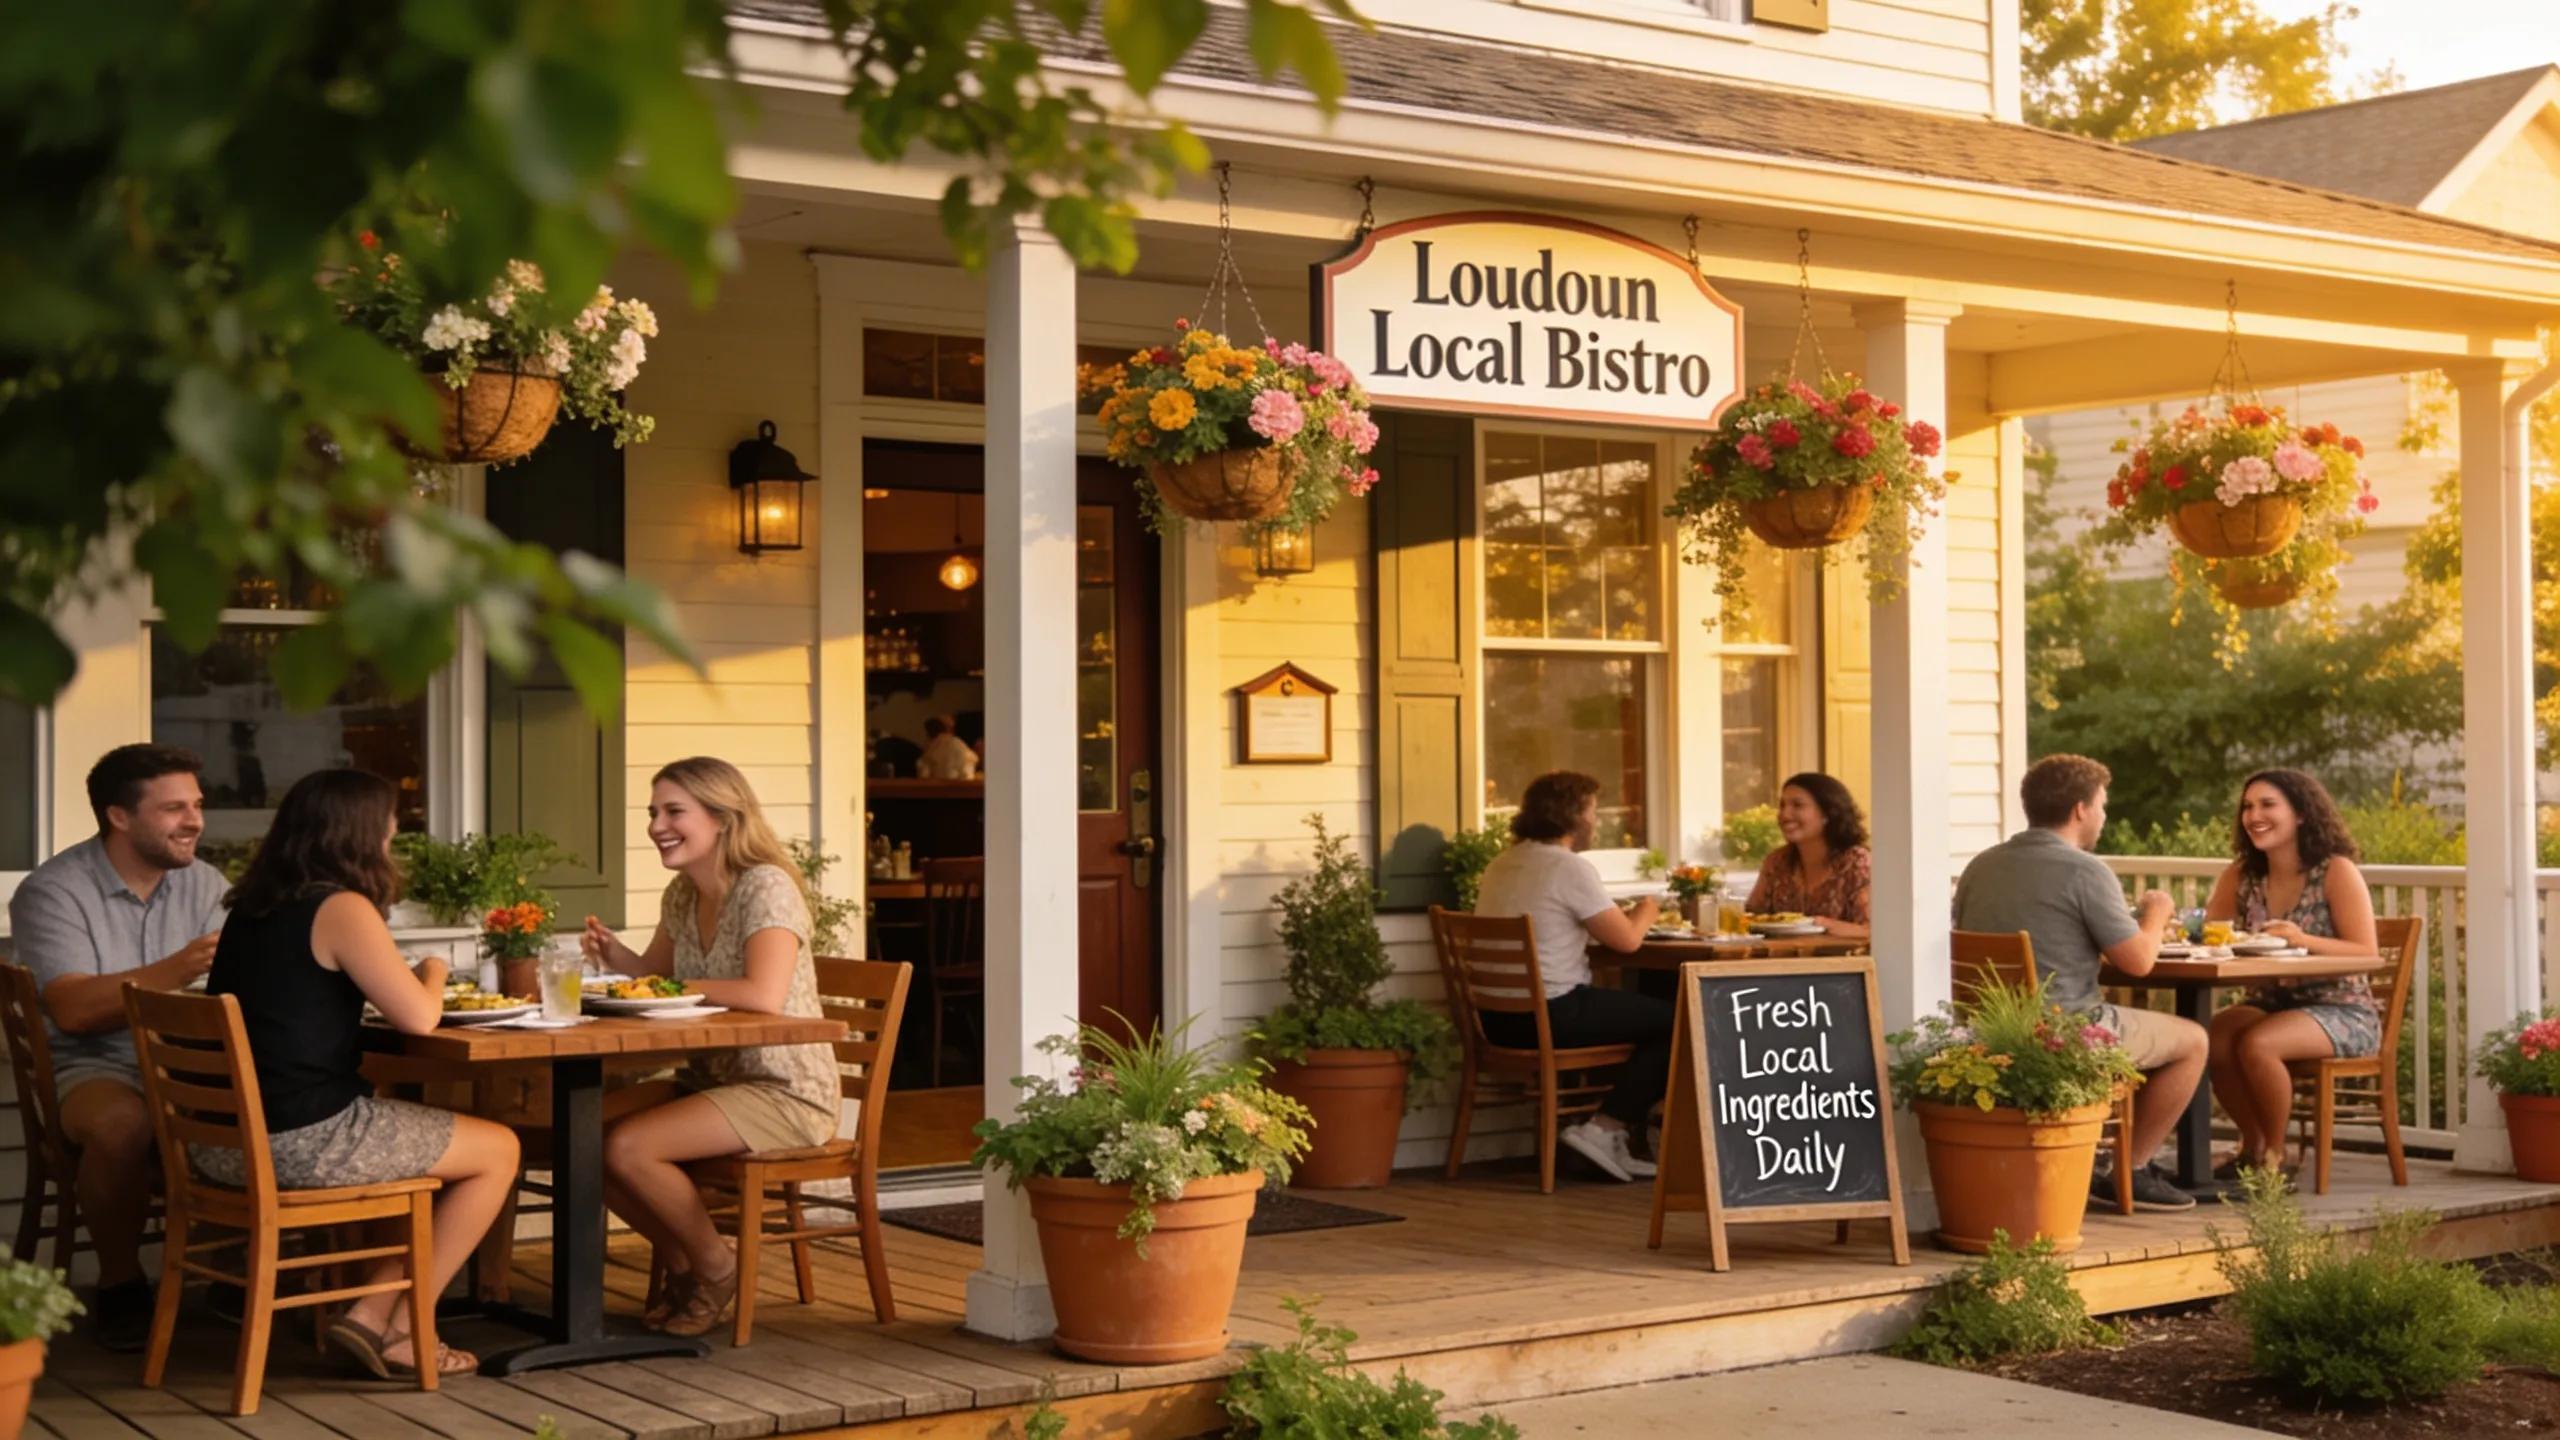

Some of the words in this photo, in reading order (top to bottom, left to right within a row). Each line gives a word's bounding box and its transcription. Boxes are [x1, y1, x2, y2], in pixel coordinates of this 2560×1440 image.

[1412, 240, 1660, 323] Loudoun
[1369, 309, 1525, 386] Local
[1543, 326, 1711, 398] Bistro
[1730, 985, 1832, 1033] Fresh
[1739, 1031, 1833, 1079] Local
[1718, 1080, 1876, 1136] Ingredients
[1755, 1129, 1845, 1191] Daily
